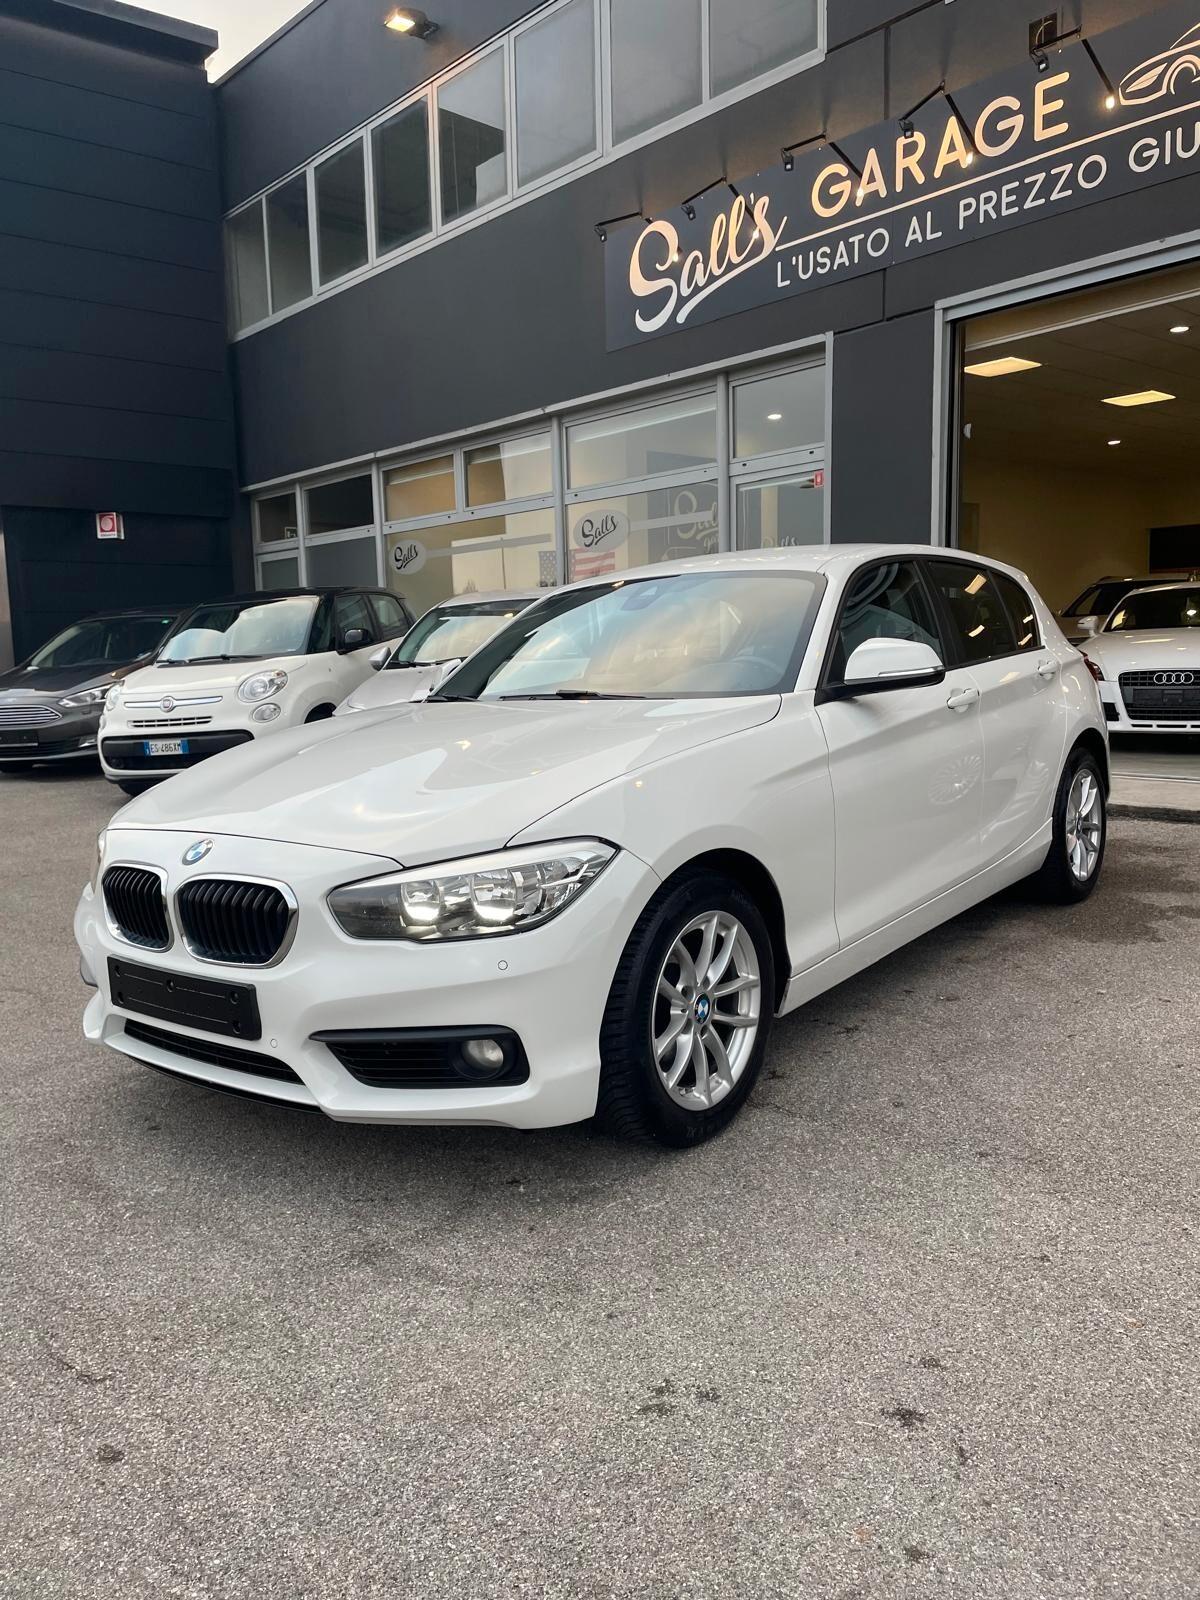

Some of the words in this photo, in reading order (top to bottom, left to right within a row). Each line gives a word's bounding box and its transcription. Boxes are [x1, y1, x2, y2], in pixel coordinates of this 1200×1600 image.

[630, 193, 787, 333] Sall's
[811, 71, 1070, 219] GARAGE
[777, 228, 890, 288] L'USATO
[904, 216, 943, 248] AL
[958, 154, 1107, 231] PREZZO
